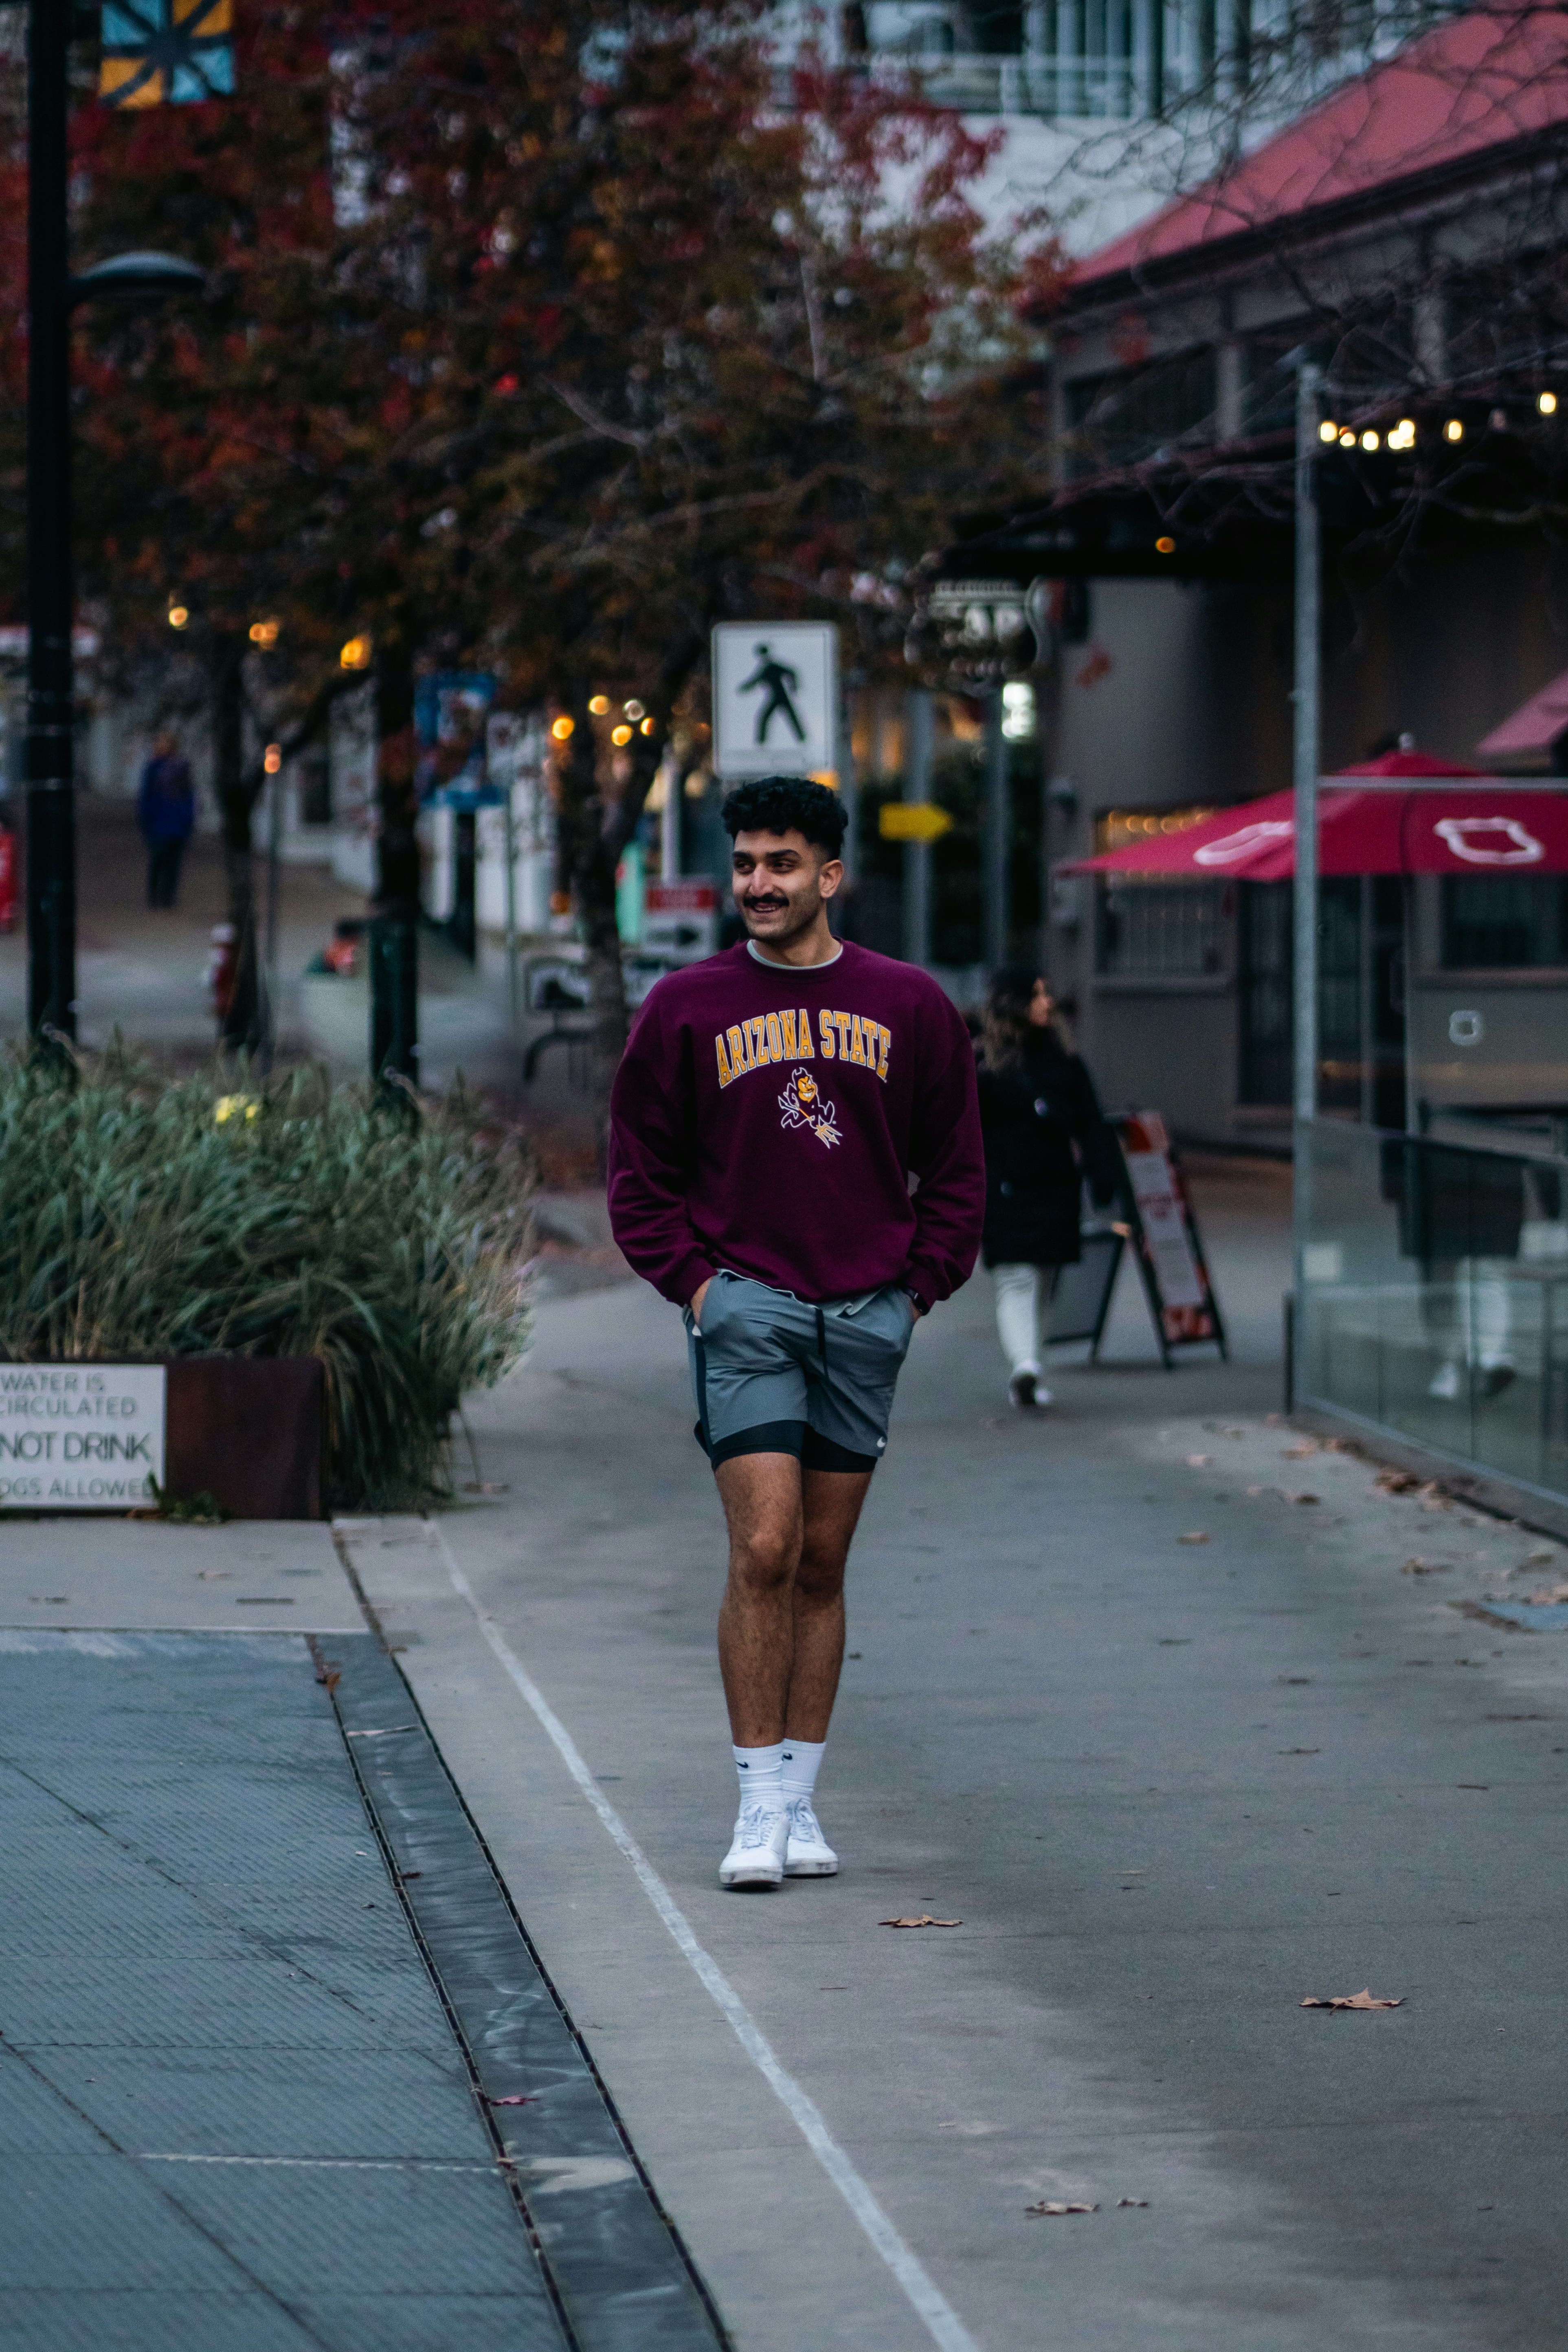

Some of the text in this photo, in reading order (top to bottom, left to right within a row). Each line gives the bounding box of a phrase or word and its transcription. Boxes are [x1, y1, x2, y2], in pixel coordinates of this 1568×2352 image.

[716, 1008, 891, 1089] ARIZONA STATE
[0, 1372, 104, 1392] WATER IS
[0, 1431, 152, 1460] NOT DRINK
